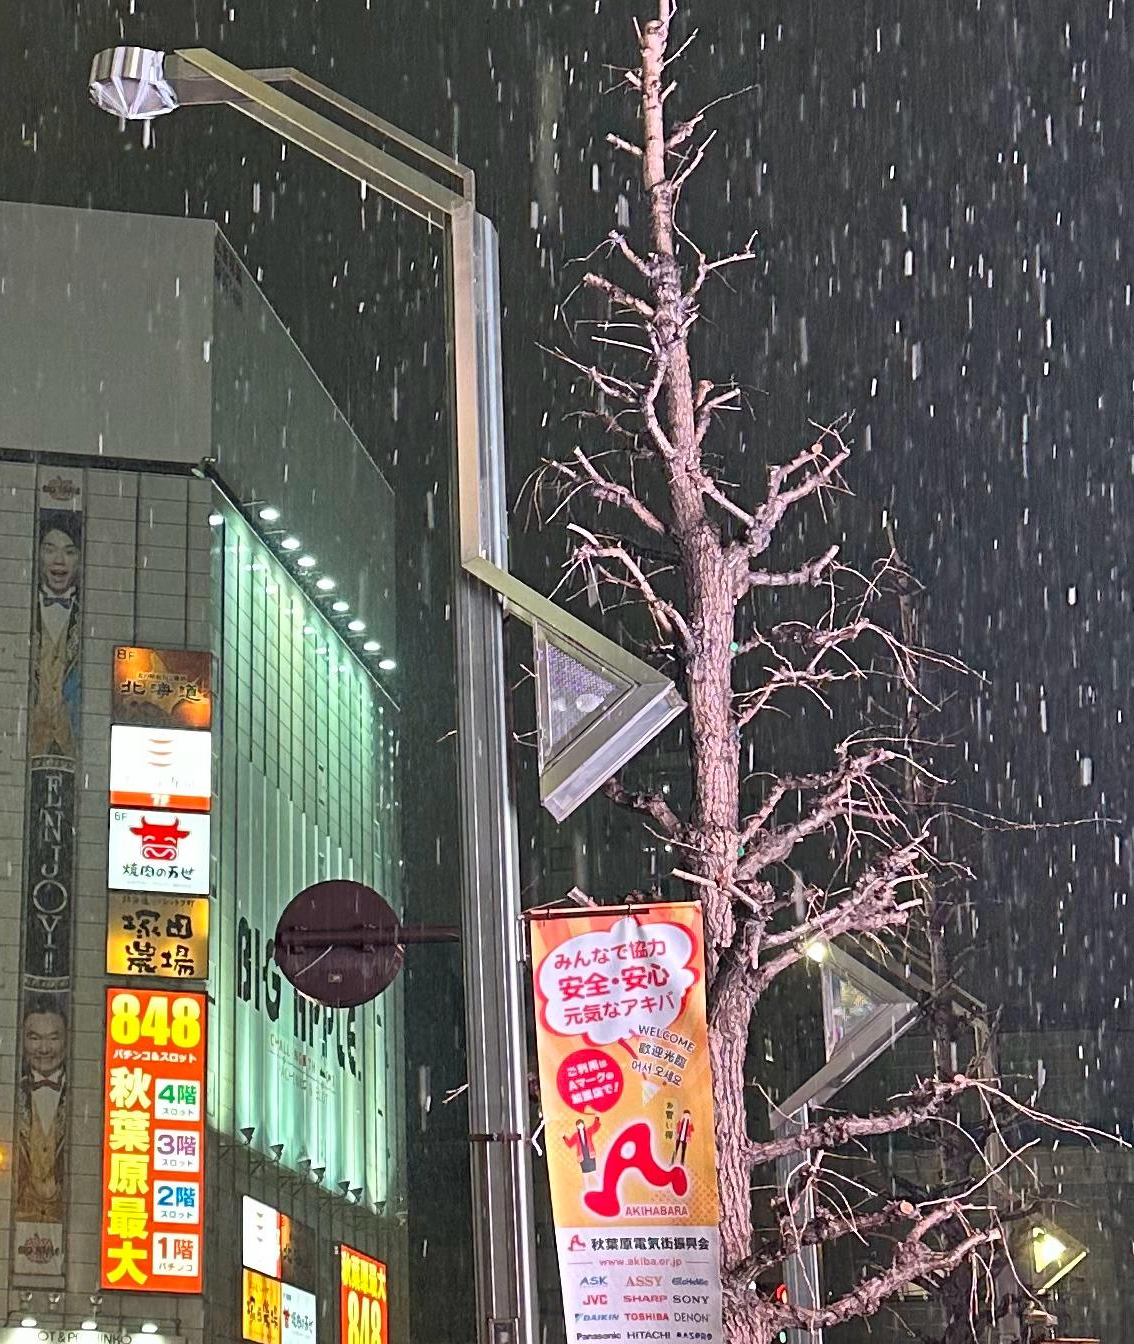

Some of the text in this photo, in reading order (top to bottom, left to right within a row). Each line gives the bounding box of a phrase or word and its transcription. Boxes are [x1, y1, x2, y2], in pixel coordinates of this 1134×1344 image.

[116, 648, 133, 661] 8F
[120, 680, 202, 702] 北海道
[114, 811, 128, 821] 6F
[122, 862, 195, 881] 焼肉の万世
[121, 908, 194, 939] 塚田
[124, 940, 196, 977] 農場
[554, 938, 666, 970] みんなで協力
[237, 916, 282, 1023] BIG
[558, 963, 670, 1002] 安全・安心
[563, 990, 676, 1027] 元気なアキバ
[110, 992, 201, 1049] 848
[638, 1024, 695, 1053] WELCOME
[112, 1049, 198, 1064] パチンコ&スロット
[631, 1059, 683, 1087] 어서 오세요
[157, 1083, 198, 1107] 4階
[162, 1107, 195, 1117] スロット
[156, 1133, 197, 1158] 3階
[161, 1158, 194, 1168] スロット
[105, 1065, 153, 1287] 秋葉原最大
[156, 1184, 197, 1208] 2階
[160, 1209, 194, 1220] スロット
[625, 1205, 689, 1216] AKIHABARA
[157, 1236, 194, 1261] 1階
[591, 1236, 710, 1252] 秋葉原電気街振興会
[158, 1261, 194, 1273] パチンコ
[599, 1256, 683, 1268] www.akiba.or.jp
[580, 1275, 608, 1287] ASK
[626, 1275, 663, 1287] ASSY
[582, 1294, 710, 1306] JVC SHARP SONY
[583, 1312, 709, 1324] DAIKIN TOSHIBA DENON
[576, 1331, 622, 1341] Panasonic
[626, 1331, 671, 1340] HITACHI
